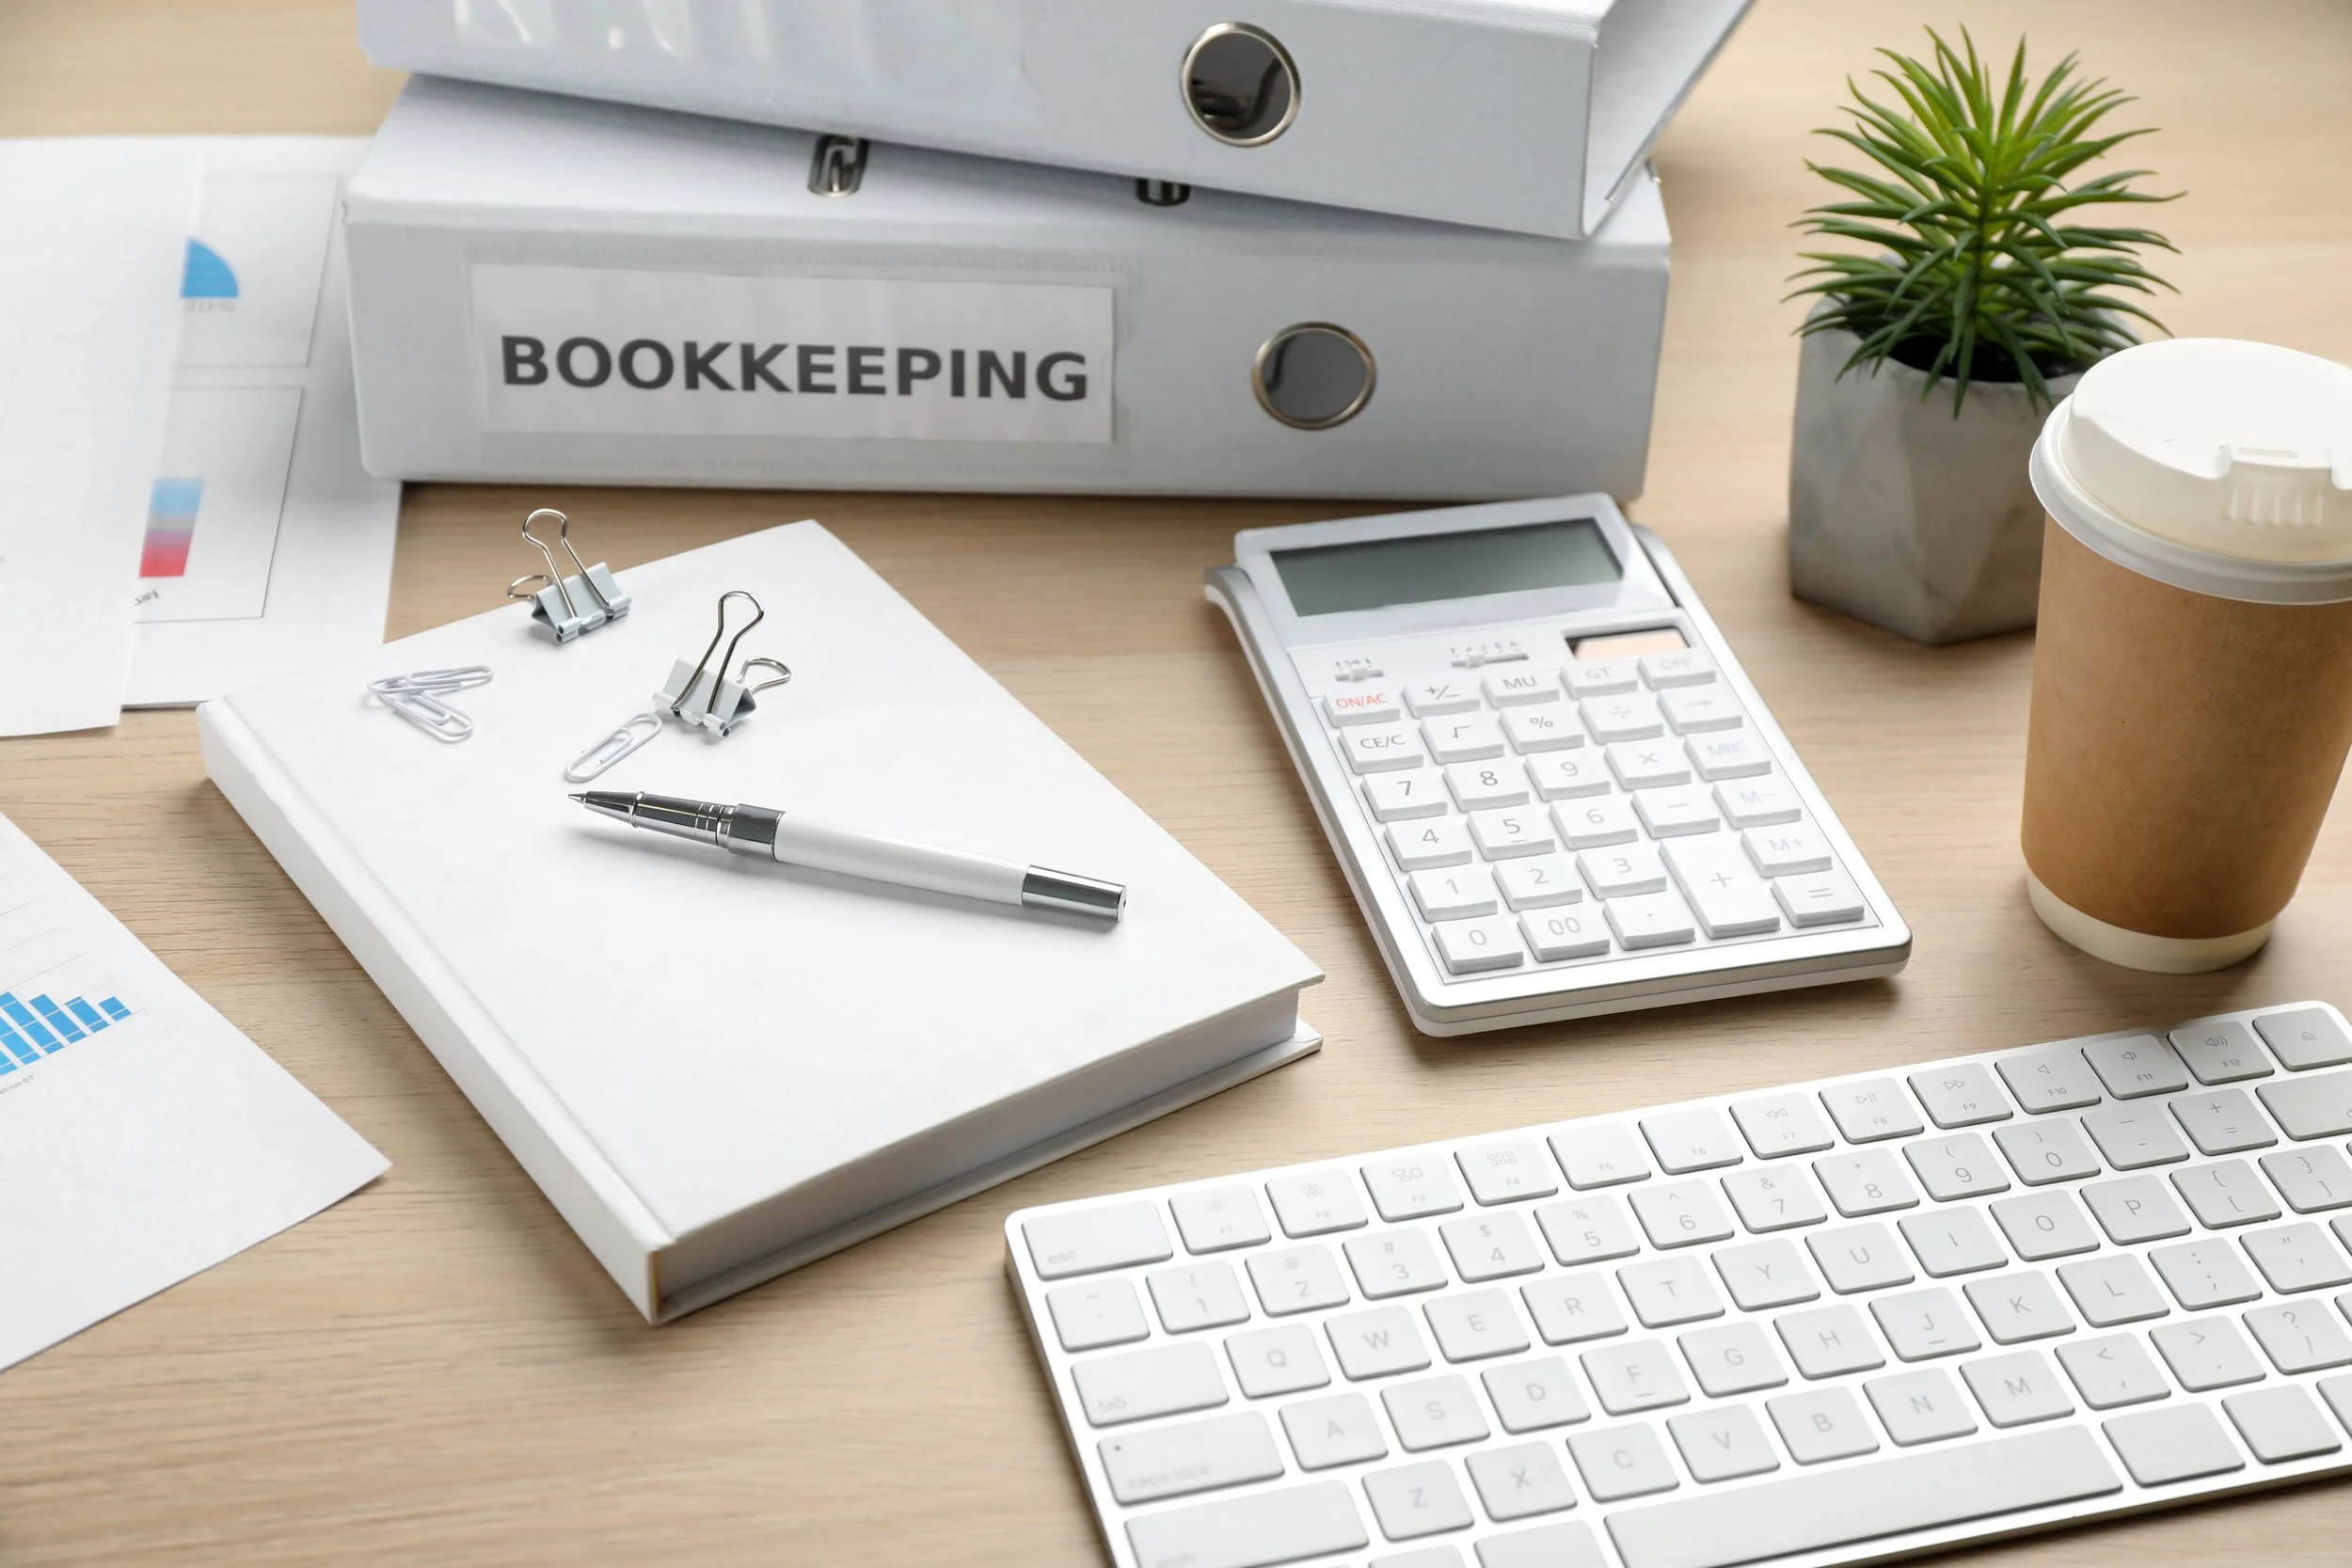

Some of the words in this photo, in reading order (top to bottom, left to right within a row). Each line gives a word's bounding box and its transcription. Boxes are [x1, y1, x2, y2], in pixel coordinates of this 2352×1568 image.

[501, 336, 1087, 402] BOOKKEEPING
[1659, 657, 1691, 670] OFF
[1585, 667, 1609, 679] GT
[1503, 676, 1536, 689] MU
[1336, 693, 1388, 708] ON/AC
[1360, 735, 1405, 749] CE/C
[1707, 741, 1748, 756] MRC
[1561, 762, 1578, 776] 9
[1480, 771, 1498, 785] 8
[1397, 781, 1411, 796] 7
[1586, 809, 1604, 824] 6
[1502, 819, 1520, 833] 5
[1422, 829, 1439, 843] 4
[1769, 838, 1804, 851] M+
[1613, 858, 1632, 873] 3
[1529, 868, 1549, 884] 2
[1446, 879, 1459, 894] 1
[1548, 917, 1581, 935] 00
[2048, 1087, 2067, 1096] F10
[1783, 1132, 1795, 1140] F7
[1598, 1163, 1613, 1171] F5
[1955, 1168, 1972, 1182] 9
[1865, 1184, 1882, 1198] 8
[1772, 1198, 1784, 1214] 7
[2125, 1200, 2141, 1215] P
[1679, 1215, 1696, 1230] 6
[1584, 1231, 1601, 1246] 5
[1047, 1251, 1077, 1264] esc
[1491, 1247, 1505, 1261] 4
[1850, 1247, 1869, 1263] U
[1393, 1264, 1409, 1280] 3
[1755, 1263, 1771, 1280] Y
[1295, 1281, 1311, 1298] 2
[1661, 1280, 1676, 1296] T
[2105, 1281, 2124, 1296] L
[1196, 1298, 1207, 1313] 1
[1565, 1298, 1583, 1314] R
[2010, 1296, 2031, 1313] K
[1468, 1314, 1486, 1332] E
[1924, 1313, 1934, 1330] J
[1363, 1330, 1388, 1349] W
[1819, 1330, 1841, 1348] H
[1267, 1350, 1287, 1368] Q
[1724, 1348, 1743, 1366] G
[1627, 1365, 1640, 1383] F
[1525, 1384, 1546, 1402] D
[2004, 1377, 2031, 1396] M
[1426, 1402, 1446, 1420] S
[1910, 1396, 1933, 1414] N
[1327, 1420, 1344, 1438] A
[1812, 1414, 1833, 1433] B
[1712, 1431, 1730, 1449] V
[1613, 1449, 1634, 1468] C
[1511, 1469, 1531, 1488] X
[1408, 1487, 1429, 1509] Z
